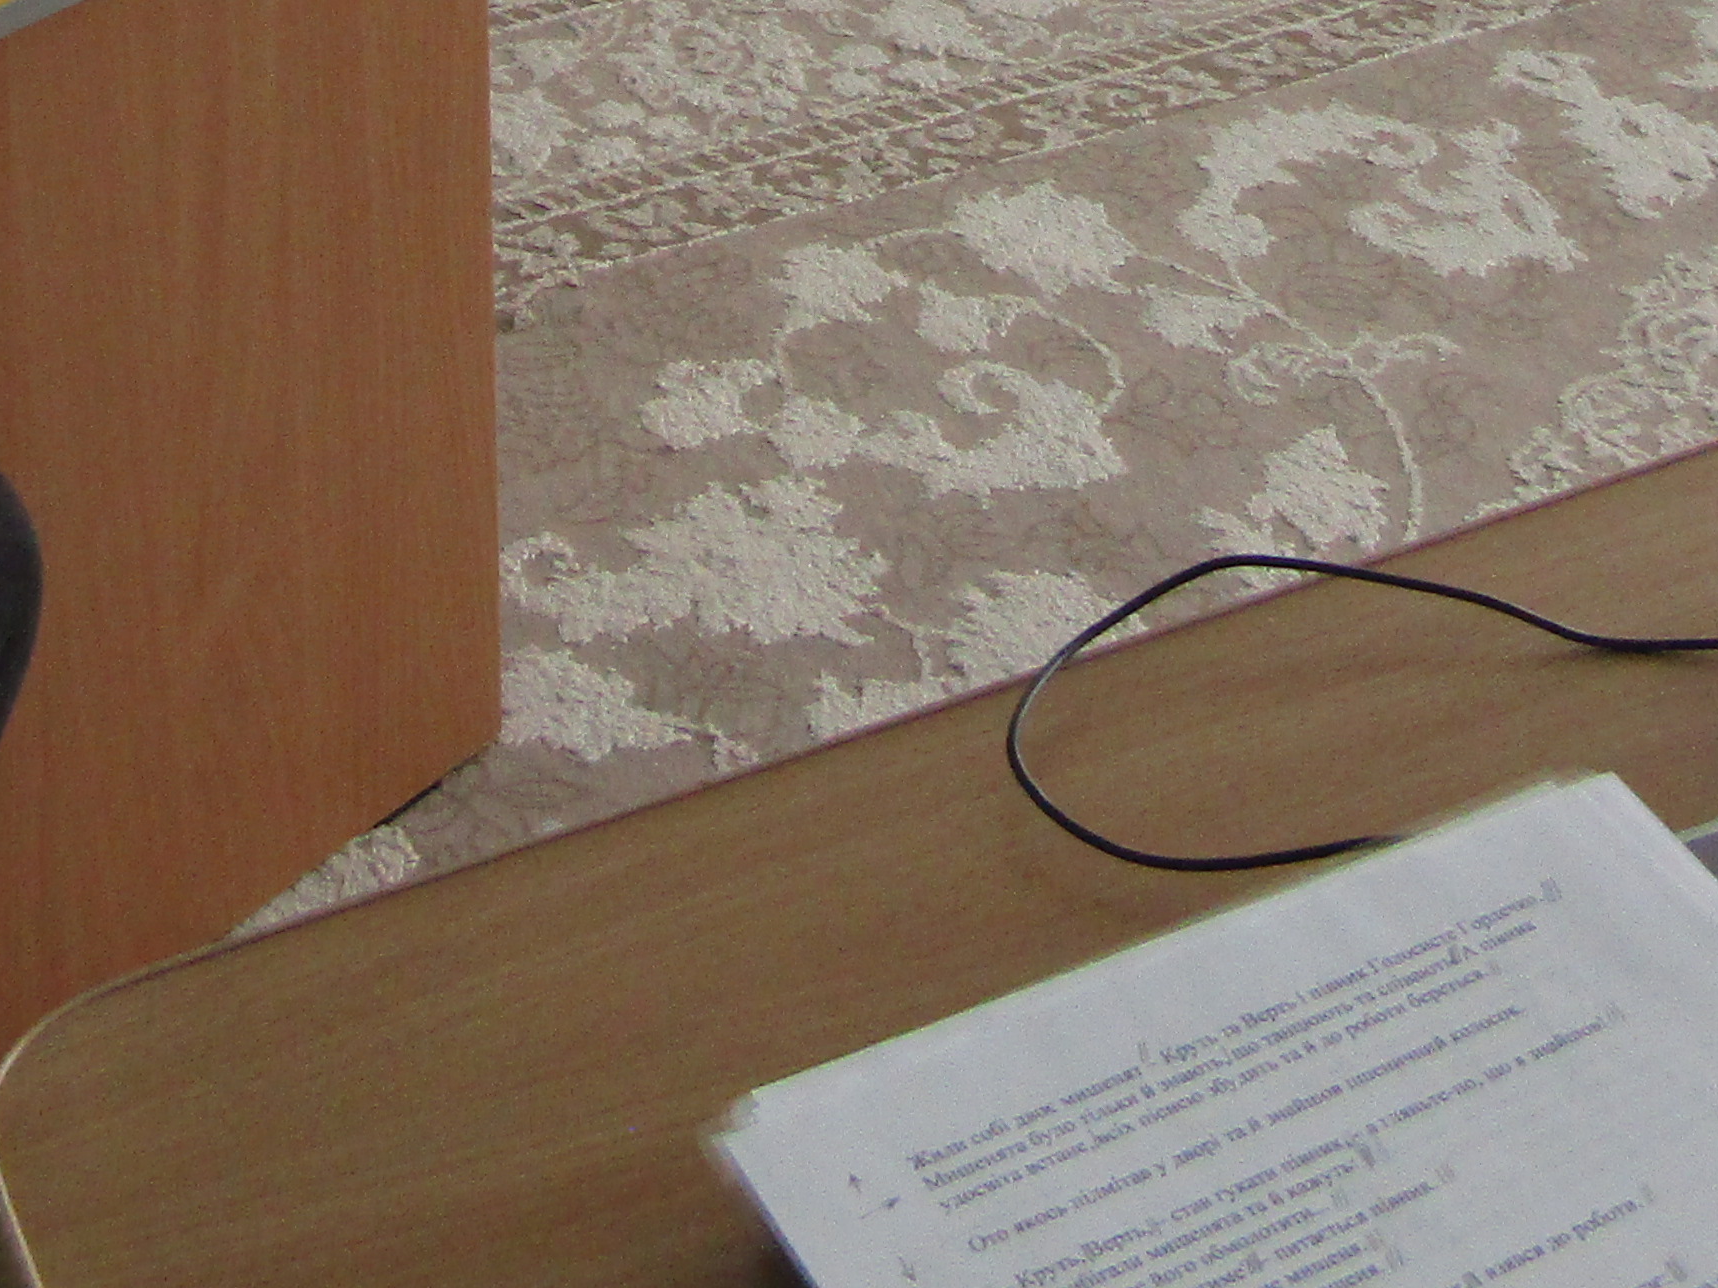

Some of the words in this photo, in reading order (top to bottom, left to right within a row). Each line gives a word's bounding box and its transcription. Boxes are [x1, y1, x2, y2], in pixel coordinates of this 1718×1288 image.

[905, 1140, 969, 1172] Жили
[969, 1119, 1011, 1146] собі
[1059, 1065, 1143, 1107] мишенят
[1159, 1035, 1220, 1066] Круть
[1238, 1001, 1298, 1030] Верть
[1308, 968, 1370, 1001] півник
[921, 1141, 1029, 1192] Мишенята
[1027, 1121, 1077, 1147] було
[1079, 1093, 1140, 1126] тільки
[1230, 1041, 1261, 1061] що
[1260, 1002, 1354, 1047] танцюють
[1353, 991, 1377, 1005] та
[1479, 921, 1538, 952] півник
[938, 1170, 1024, 1216] удосвіта
[1096, 1123, 1137, 1145] всіх
[1138, 1092, 1205, 1128] піснею
[1207, 1061, 1280, 1097] збудить
[1279, 1049, 1304, 1065] та
[1321, 1031, 1343, 1049] до
[1343, 1003, 1408, 1041] роботи
[1406, 969, 1491, 1009] береться.
[966, 1228, 1010, 1254] Ото
[1012, 1206, 1069, 1236] якось
[1152, 1163, 1168, 1179] у
[1171, 1134, 1222, 1170] дворі
[1222, 1127, 1249, 1143] та
[1264, 1084, 1344, 1127] знайшов
[1344, 1035, 1449, 1091] пшеничний
[1170, 1196, 1214, 1223] став
[1213, 1167, 1279, 1204] гукати
[1482, 1062, 1513, 1084] що
[1145, 1212, 1245, 1261] мишенята
[1244, 1201, 1269, 1217] та
[1149, 1260, 1198, 1288] його
[1273, 1211, 1369, 1261] питається
[1284, 1243, 1363, 1285] мишеня.
[1483, 1244, 1547, 1281] взявся
[1545, 1232, 1573, 1253] до
